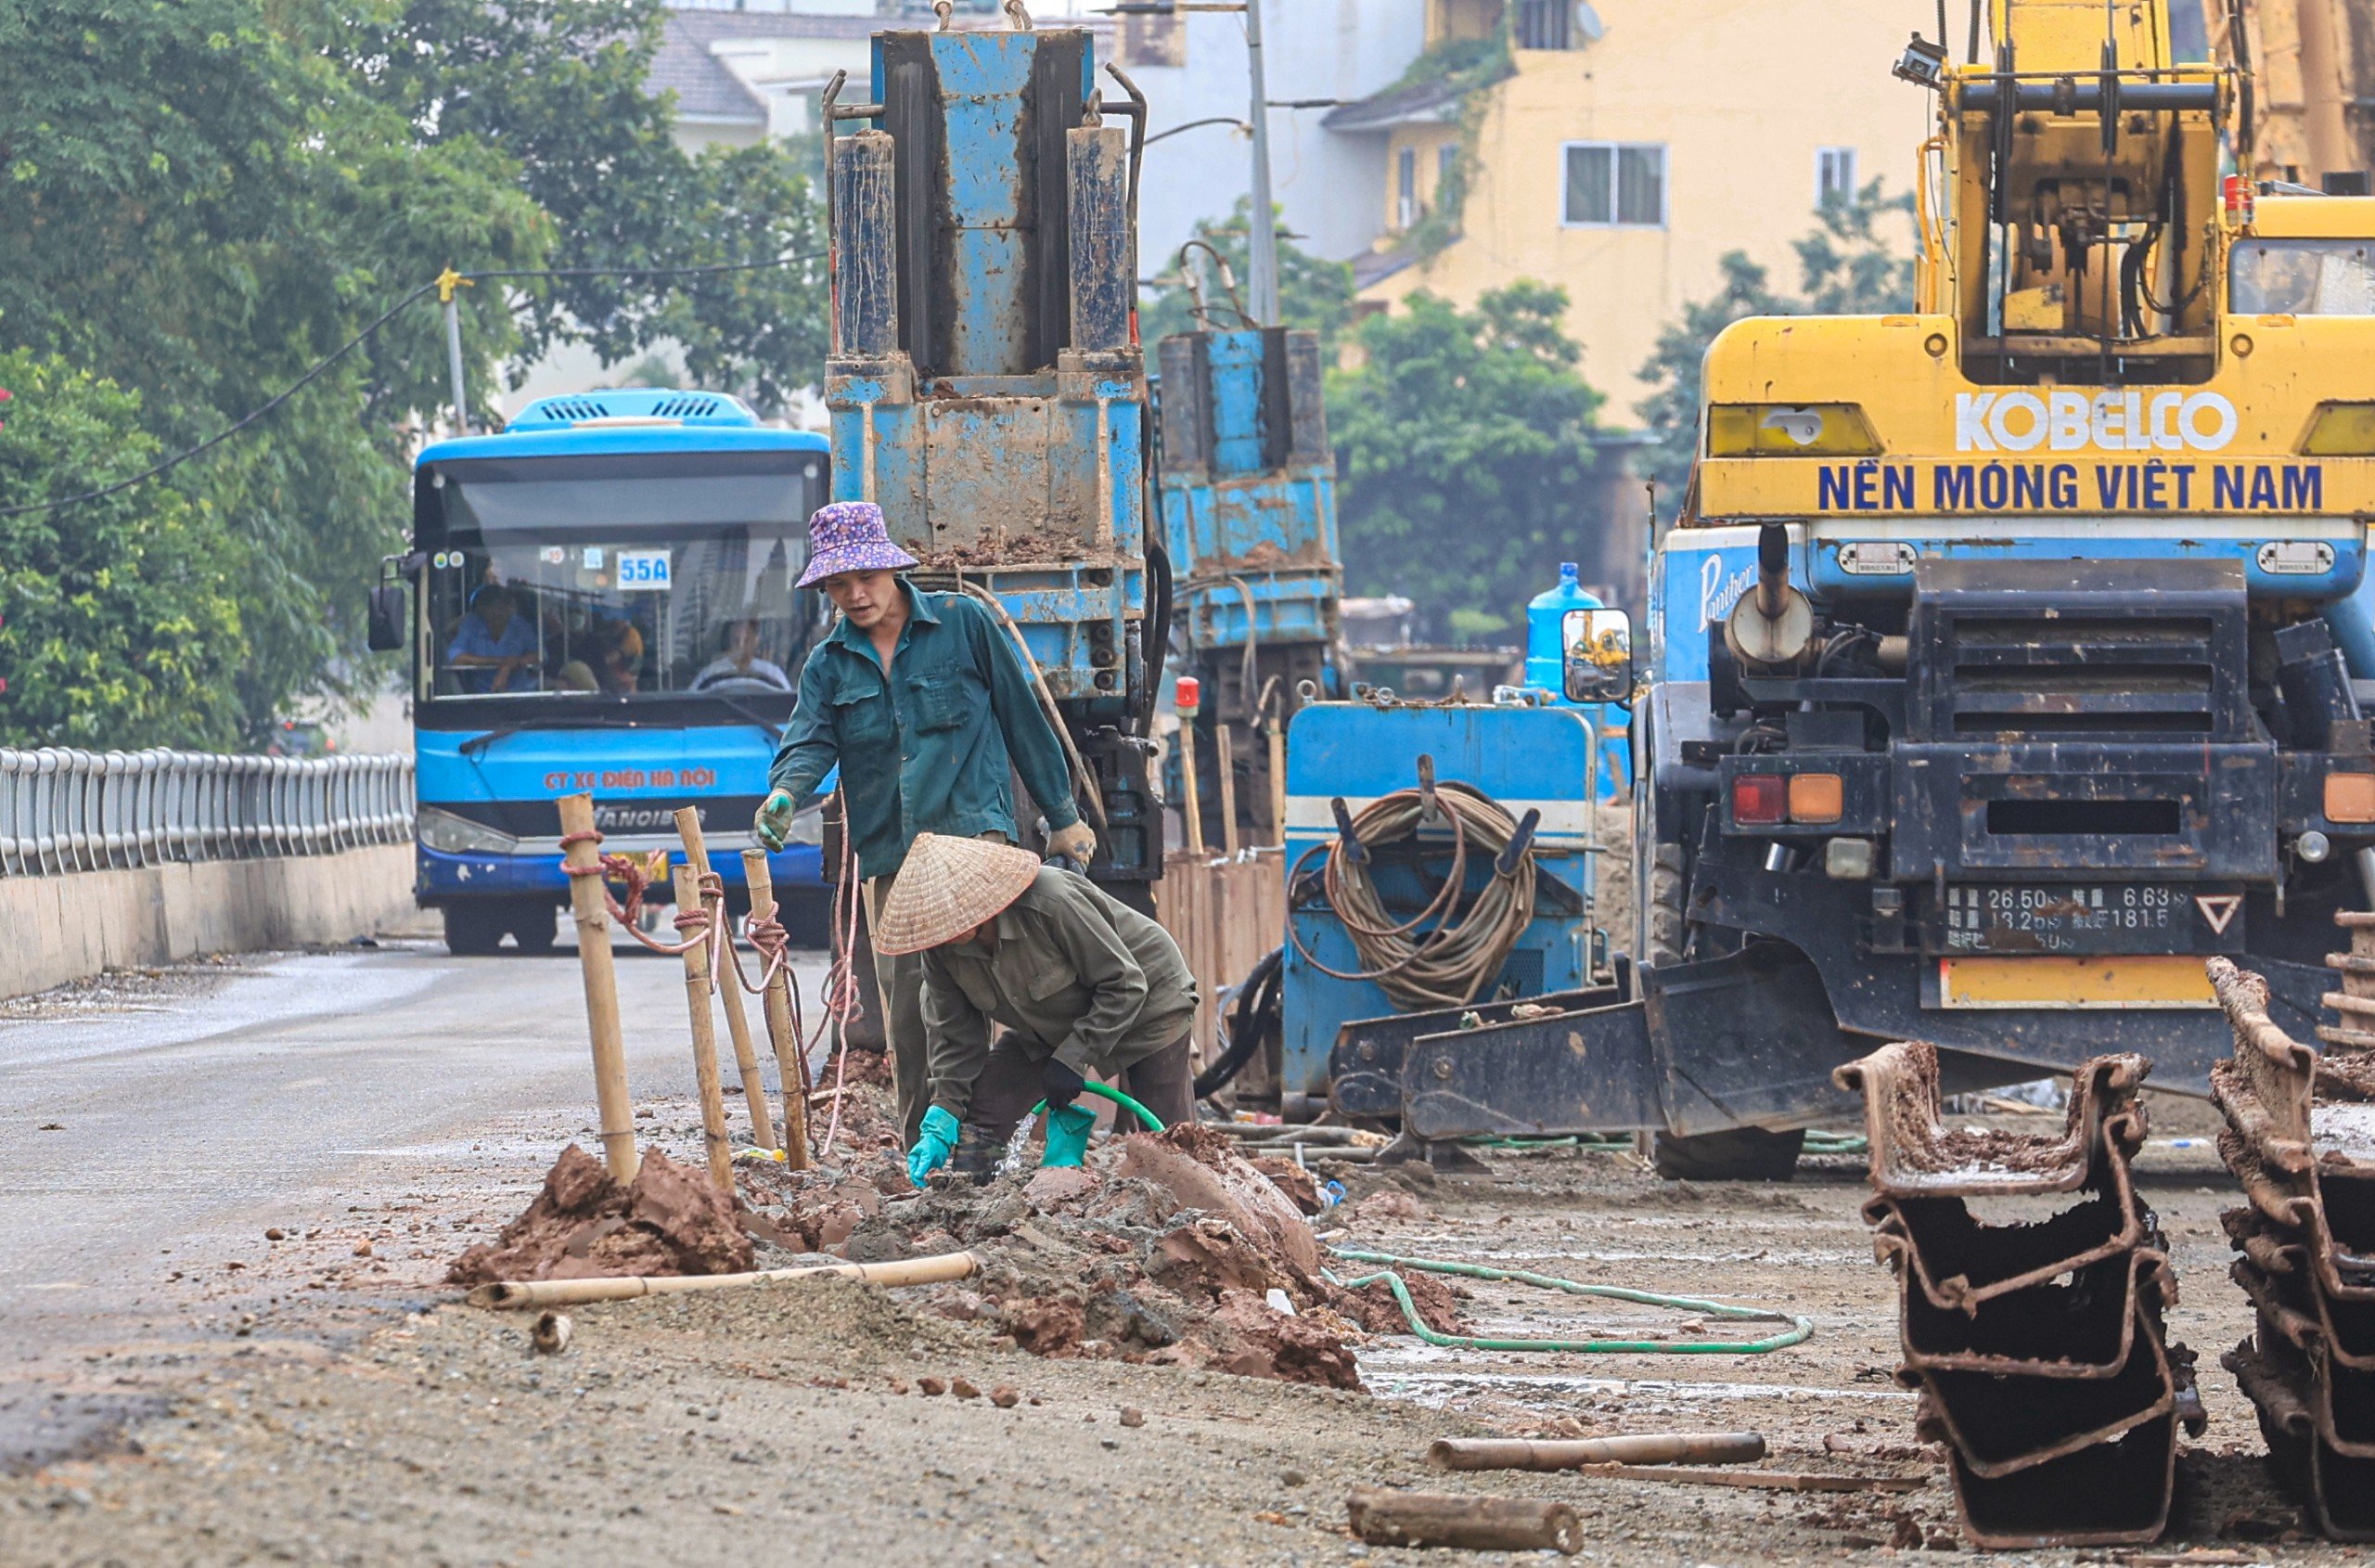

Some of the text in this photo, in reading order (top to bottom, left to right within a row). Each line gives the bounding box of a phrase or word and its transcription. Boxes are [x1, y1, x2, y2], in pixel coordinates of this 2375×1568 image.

[1956, 392, 2238, 452] KOBELCO
[1934, 458, 2078, 509] MÓNG
[2214, 465, 2322, 509] NAM
[621, 558, 668, 581] 55A
[1698, 554, 1753, 634] Panther
[545, 772, 569, 789] CT
[574, 772, 596, 788] XE
